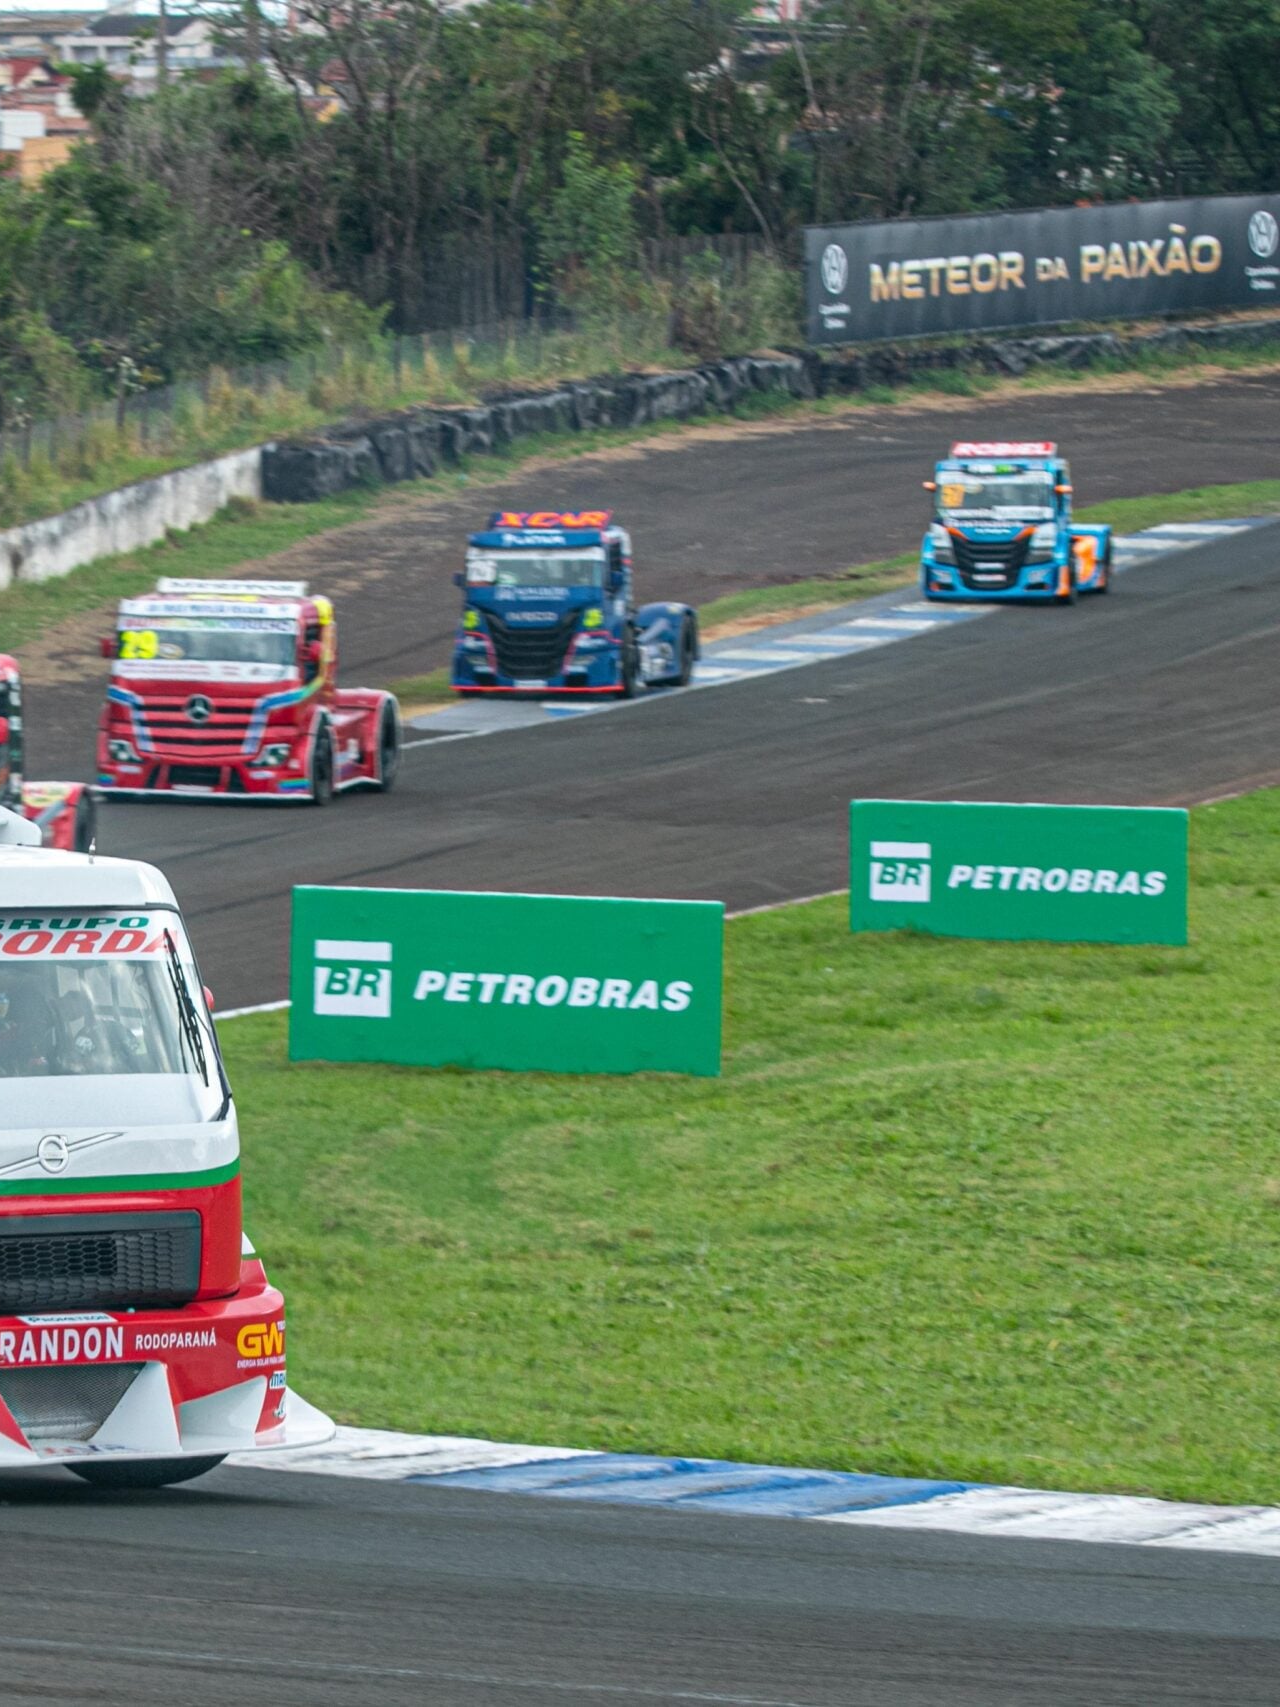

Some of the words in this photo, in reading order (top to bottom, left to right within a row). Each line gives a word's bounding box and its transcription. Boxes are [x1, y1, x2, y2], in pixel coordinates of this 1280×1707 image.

[869, 250, 1025, 302] METEOR
[1036, 257, 1069, 281] DA
[1080, 223, 1222, 284] PAIXÃO
[946, 864, 1168, 896] PETROBRAS
[323, 967, 381, 997] BR
[413, 970, 694, 1013] PETROBRAS
[0, 1326, 124, 1363] RANDON
[135, 1327, 217, 1350] RODOPARANÁ
[236, 1322, 283, 1358] GW
